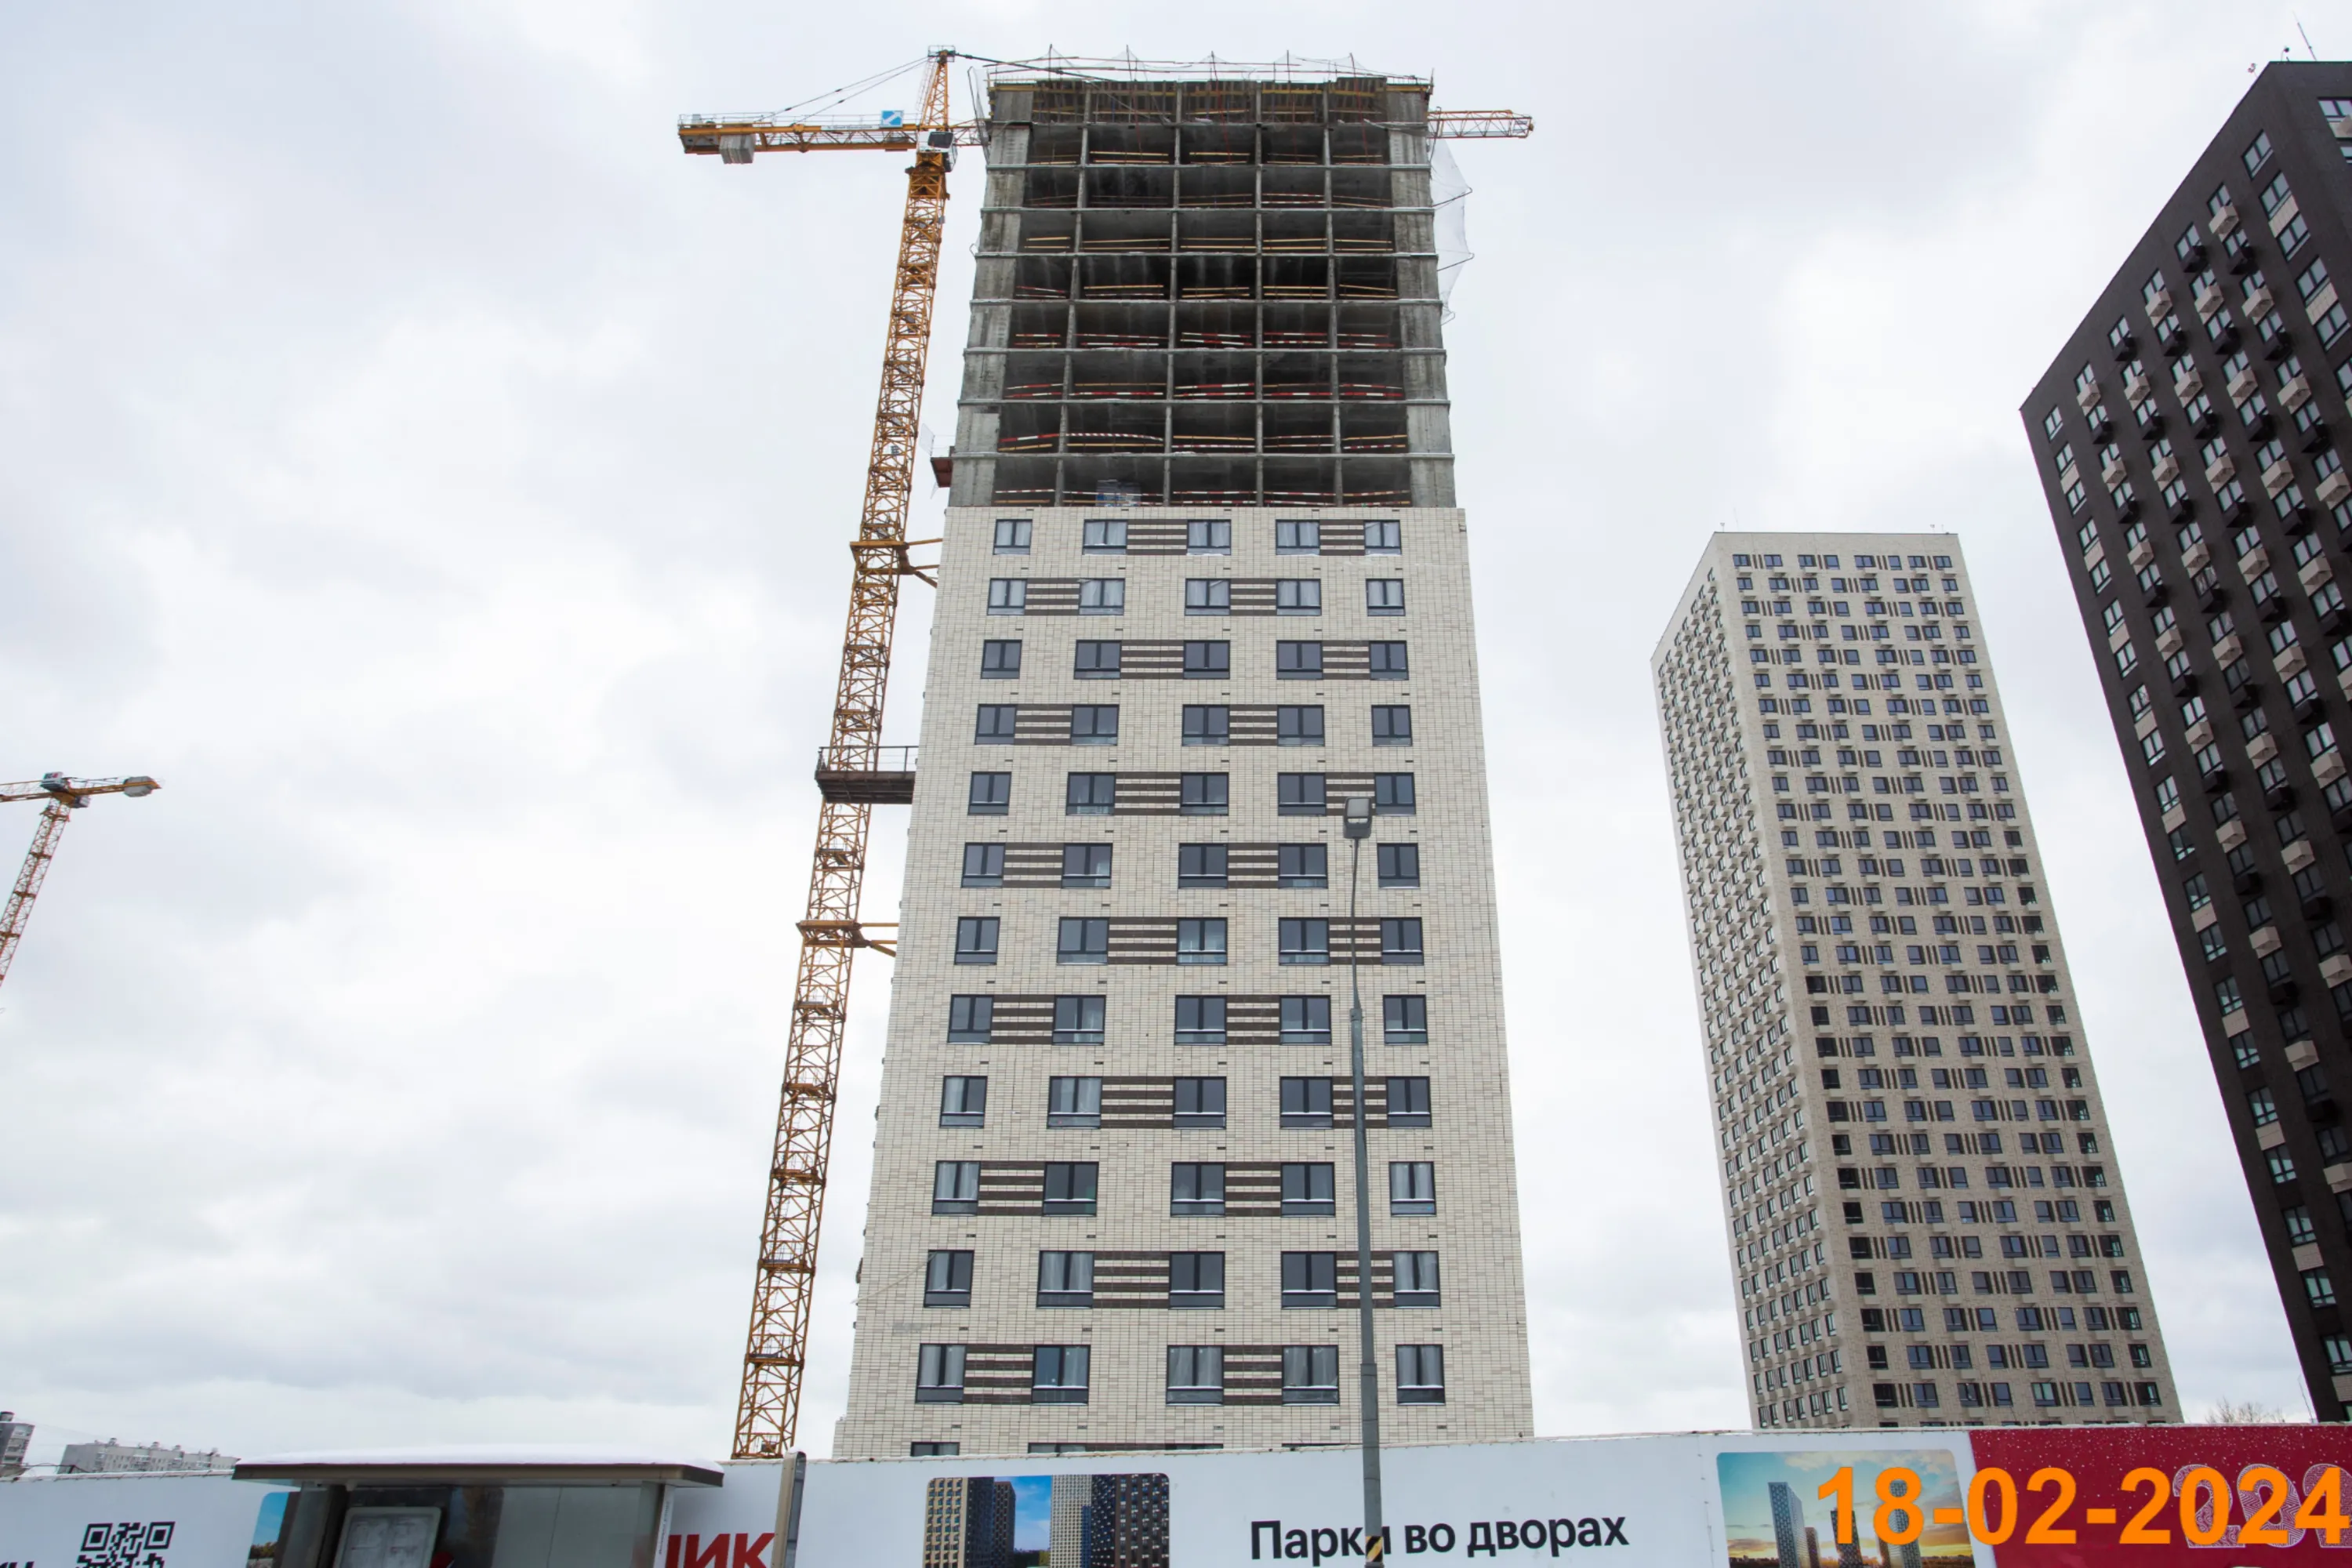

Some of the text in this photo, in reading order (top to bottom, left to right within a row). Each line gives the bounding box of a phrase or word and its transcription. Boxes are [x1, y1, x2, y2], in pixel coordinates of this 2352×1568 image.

[666, 1533, 775, 1568] ИК
[1405, 1523, 1456, 1554] во
[1467, 1516, 1630, 1558] дворах
